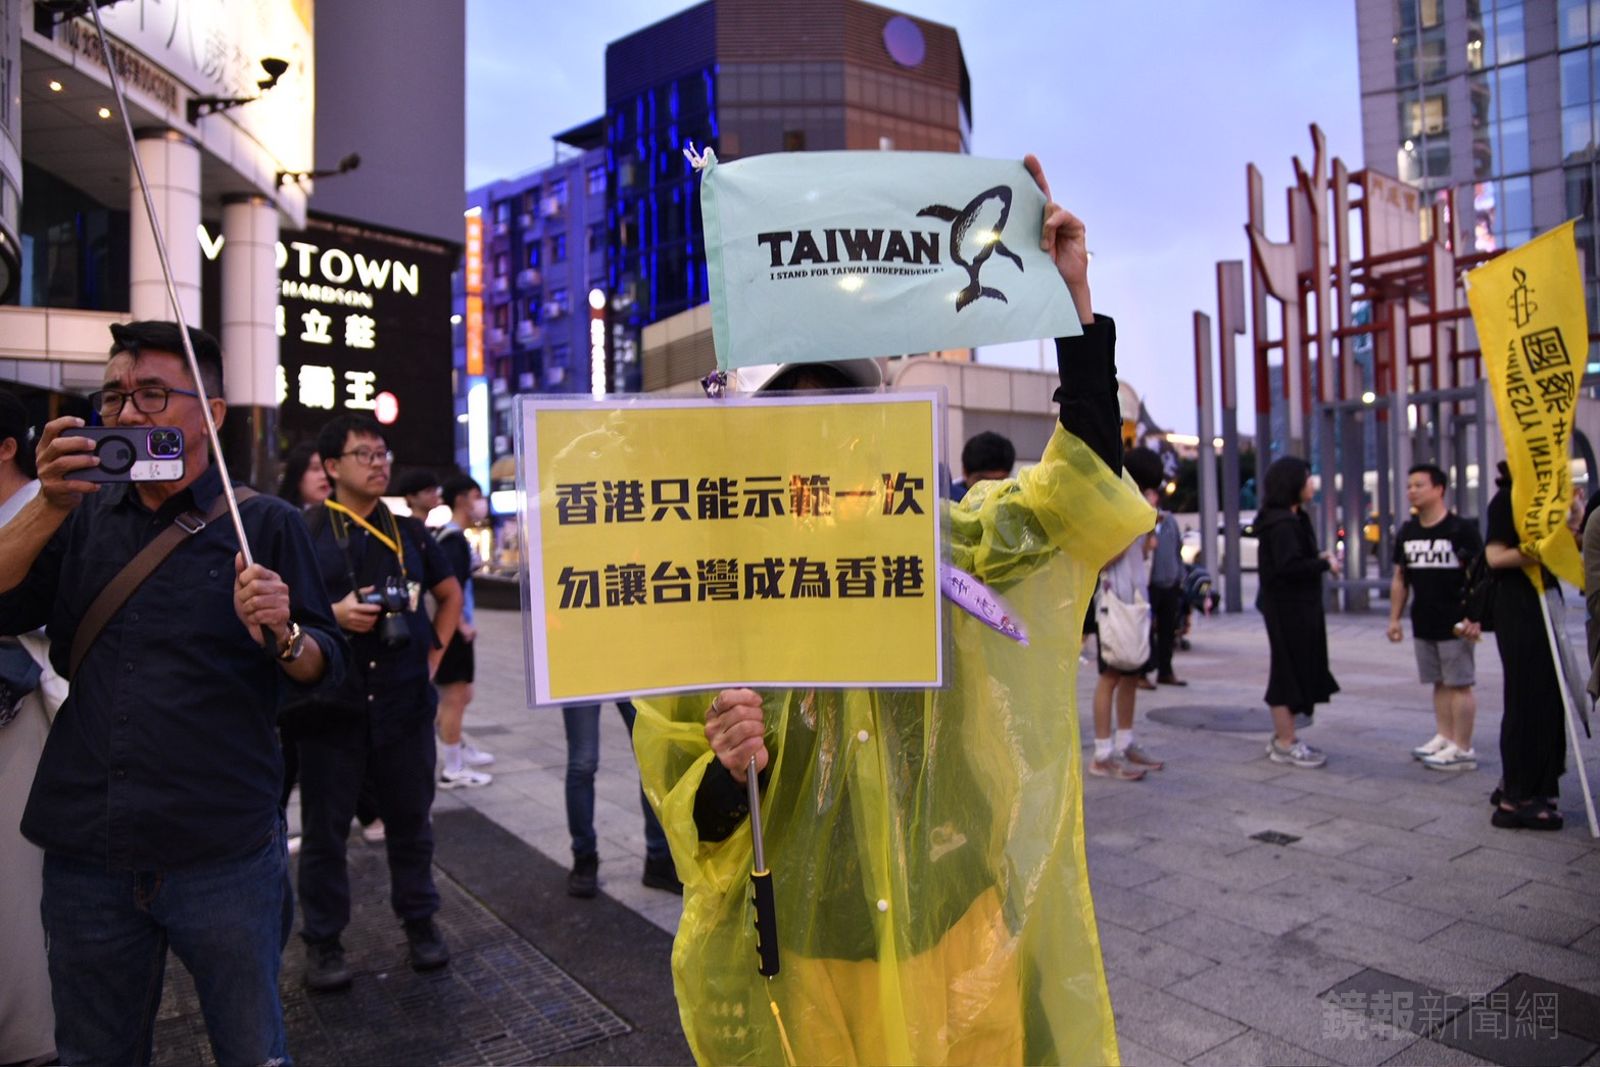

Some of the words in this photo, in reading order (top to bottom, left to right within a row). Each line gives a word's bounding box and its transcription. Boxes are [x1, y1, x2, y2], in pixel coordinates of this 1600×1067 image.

[758, 229, 941, 267] TAIWAN
[770, 272, 775, 280] I
[777, 270, 808, 280] STAND
[811, 268, 829, 277] FOR
[831, 266, 869, 275] TAIWAN
[555, 472, 925, 525] 香港只能示範一次
[557, 555, 925, 609] 勿讓台灣成為香港
